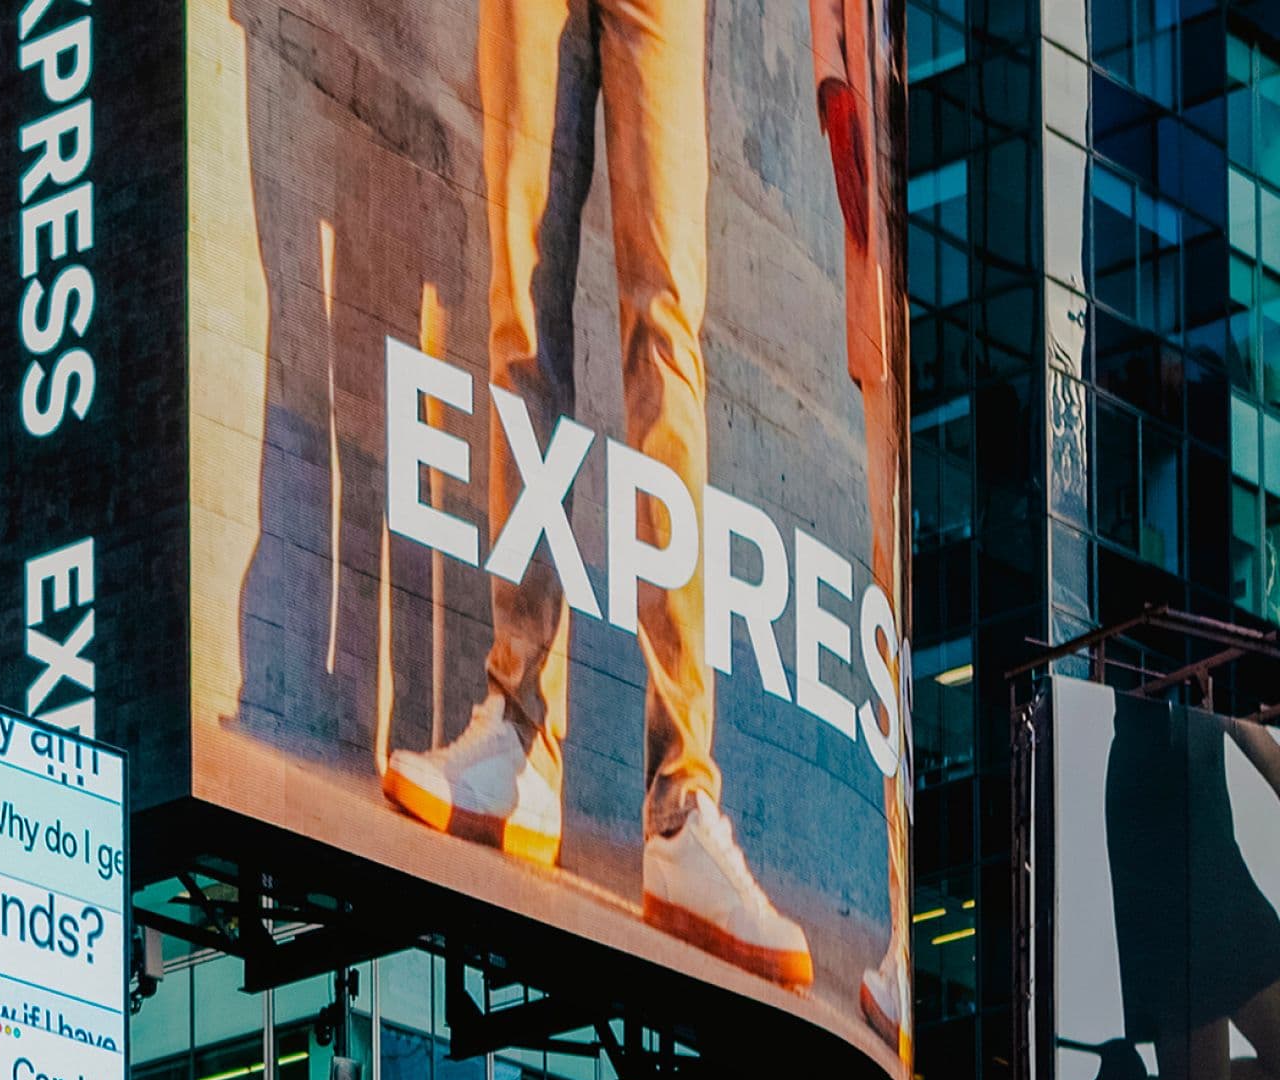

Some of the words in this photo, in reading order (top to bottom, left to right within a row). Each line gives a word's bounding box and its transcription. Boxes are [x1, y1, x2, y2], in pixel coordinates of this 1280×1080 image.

[24, 535, 95, 740] EX
[44, 818, 78, 858] do
[84, 828, 90, 864] I
